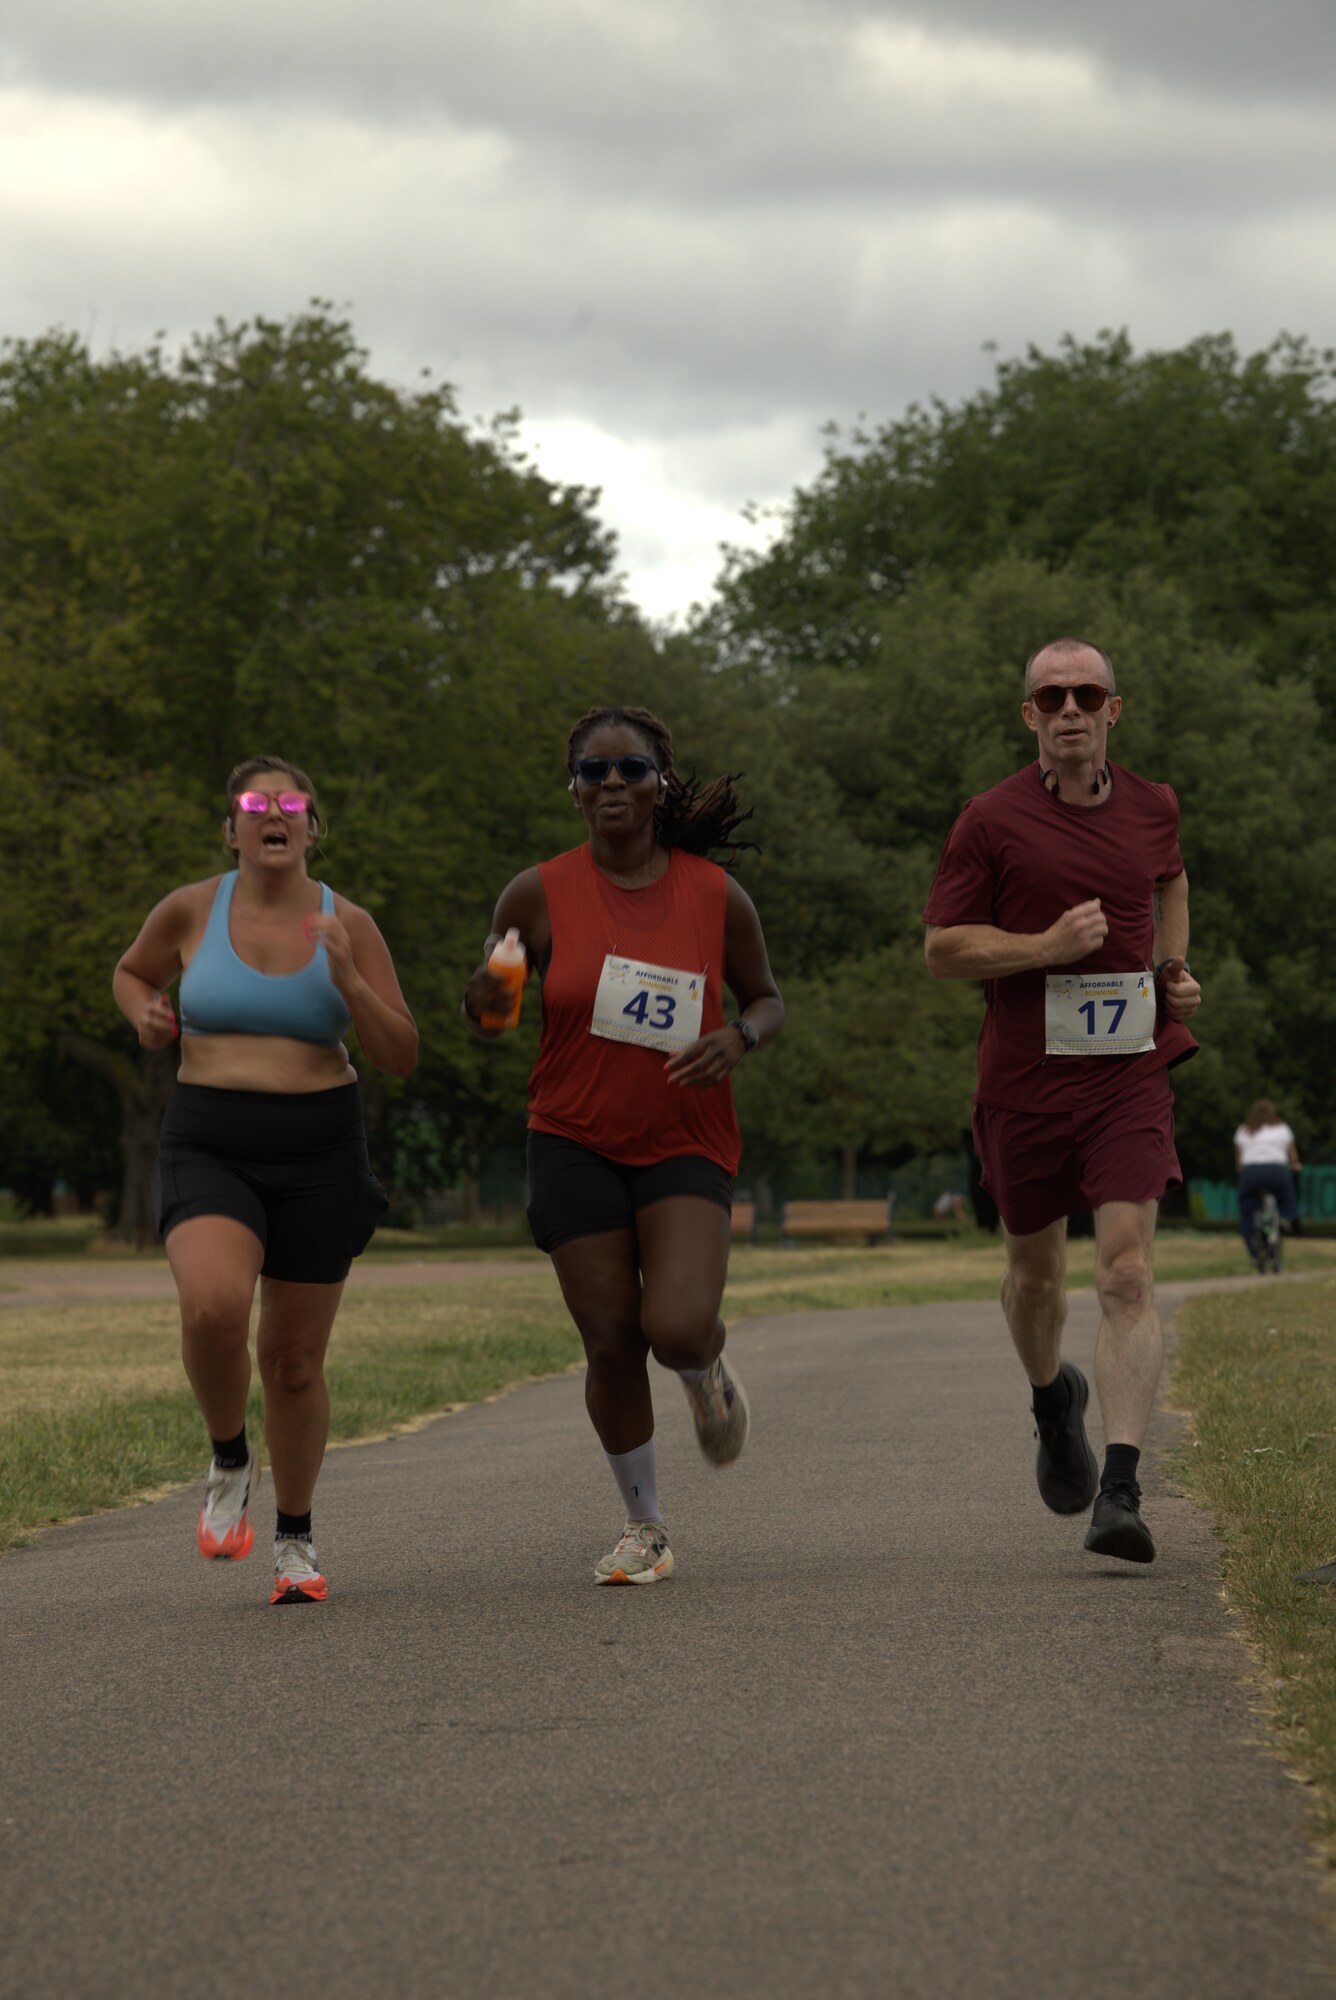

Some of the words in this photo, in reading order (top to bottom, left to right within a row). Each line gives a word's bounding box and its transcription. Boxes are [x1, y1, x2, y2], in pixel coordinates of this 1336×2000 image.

[635, 970, 679, 985] AFFORDABLE
[1137, 976, 1144, 989] A
[689, 979, 696, 991] A
[1085, 989, 1119, 997] RUNNING
[1142, 986, 1149, 998] R
[622, 990, 677, 1031] 43
[1078, 999, 1128, 1035] 17
